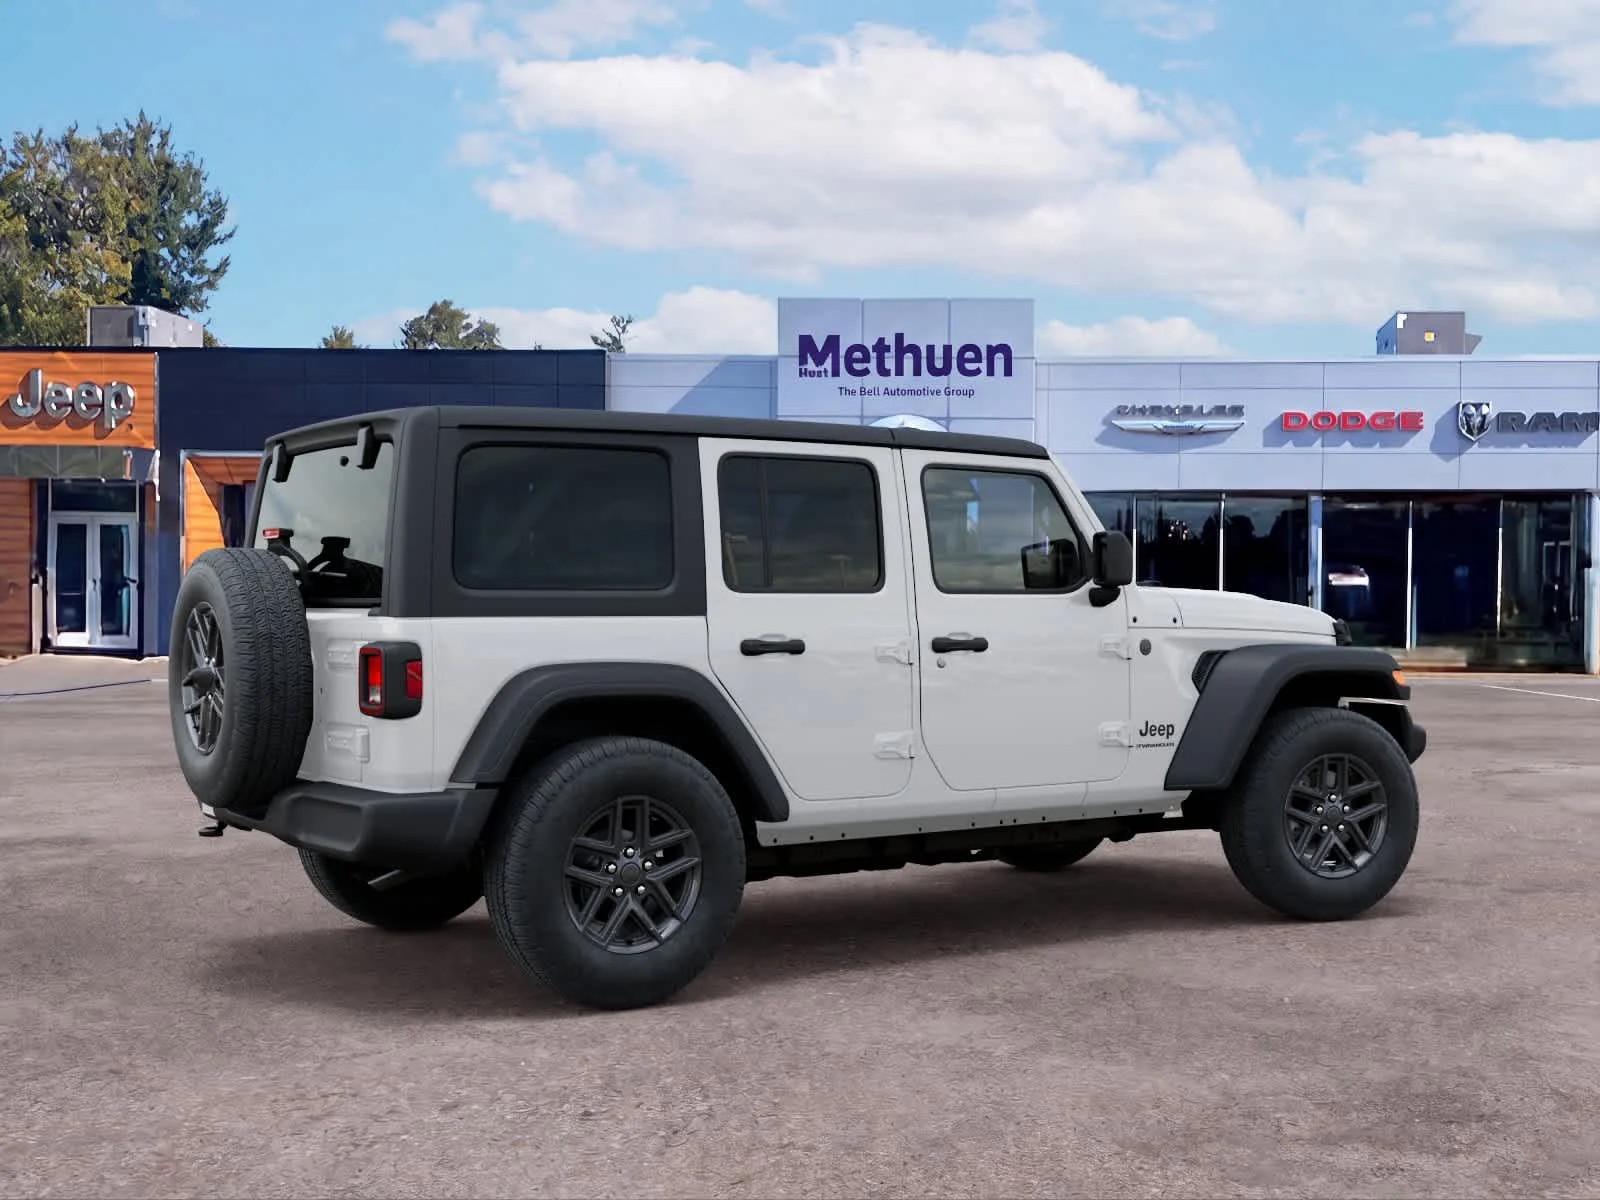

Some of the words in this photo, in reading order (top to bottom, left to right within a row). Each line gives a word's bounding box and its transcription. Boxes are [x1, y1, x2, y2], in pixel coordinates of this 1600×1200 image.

[799, 333, 1013, 378] Methuen
[10, 368, 136, 429] Jeep
[838, 386, 857, 397] The
[859, 386, 880, 397] Bell
[883, 386, 941, 397] Automotive
[943, 386, 975, 399] Group
[1282, 410, 1424, 431] DODGE
[1497, 411, 1599, 433] RAM
[1139, 720, 1175, 740] Jeep
